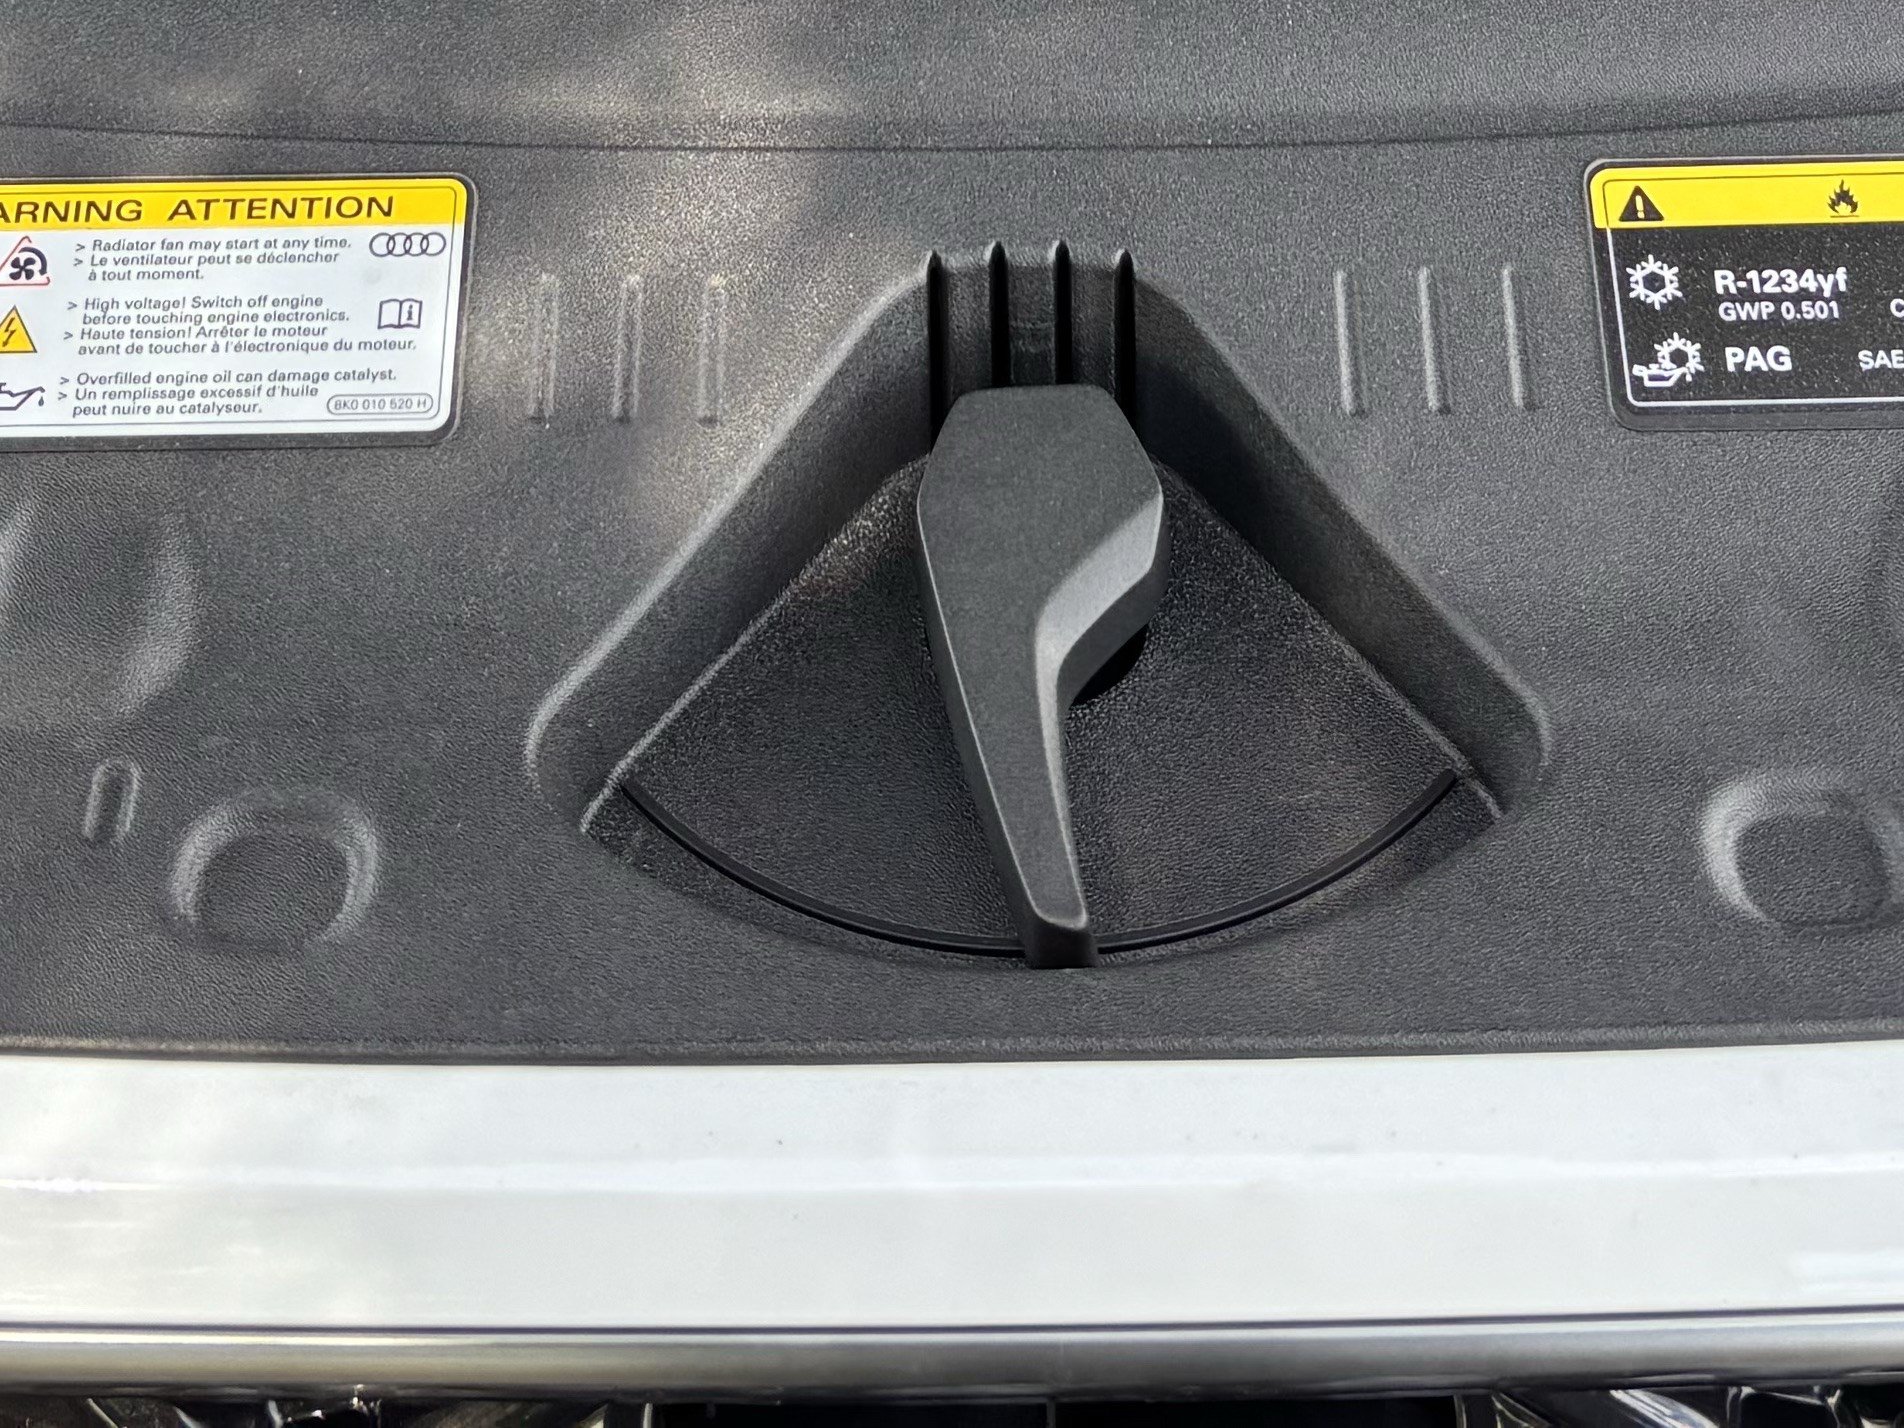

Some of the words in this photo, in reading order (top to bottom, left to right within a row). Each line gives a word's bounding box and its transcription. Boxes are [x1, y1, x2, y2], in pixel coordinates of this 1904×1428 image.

[167, 195, 394, 222] ATTENTION
[92, 237, 156, 252] Radiator
[161, 237, 184, 251] fan
[188, 240, 222, 253] may
[225, 237, 259, 250] start
[263, 238, 278, 249] at
[282, 238, 311, 251] any
[314, 235, 352, 248] time.
[90, 253, 109, 267] Le
[113, 253, 194, 266] ventilateur
[197, 254, 231, 267] peut
[236, 254, 252, 264] se
[256, 251, 340, 265] déclencher
[102, 269, 131, 282] tout
[136, 268, 204, 281] moment.
[1714, 266, 1848, 298] R-1234yf
[83, 297, 120, 313] High
[191, 295, 243, 310] Switch
[247, 294, 269, 309] off
[271, 294, 324, 310] engine
[1718, 301, 1775, 322] GWP
[1781, 299, 1840, 321] 0.501
[82, 311, 131, 326] before
[136, 310, 203, 326] touching
[207, 309, 259, 325] engine
[263, 308, 350, 323] electronics.
[80, 327, 125, 341] Haute
[254, 325, 268, 337] le
[272, 325, 328, 338] moteur
[78, 343, 121, 355] avant
[125, 341, 144, 355] de
[148, 340, 207, 355] toucher
[333, 338, 353, 351] du
[358, 338, 417, 352] moteur.
[1725, 345, 1793, 372] PAG
[1858, 350, 1904, 371] SAE
[77, 371, 152, 387] Overfilled
[156, 370, 209, 387] engine
[213, 370, 232, 384] oil
[236, 372, 264, 384] can
[267, 369, 331, 385] damage
[334, 367, 398, 384] catalyst.
[75, 387, 97, 401] Un
[101, 387, 197, 403] remplissage
[200, 384, 263, 399] excessif
[72, 404, 108, 419] peut
[112, 402, 151, 416] nuire
[156, 404, 175, 416] au
